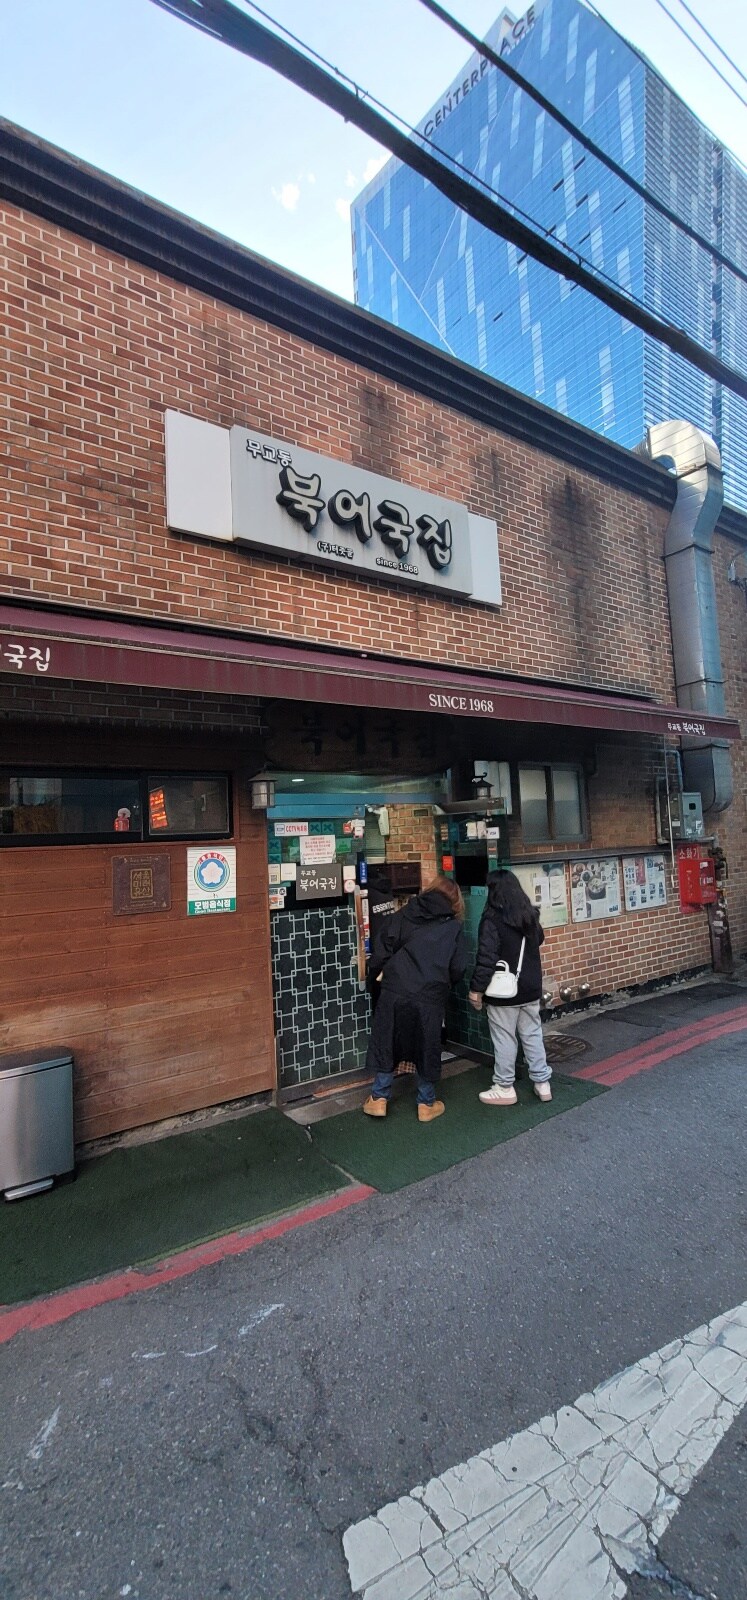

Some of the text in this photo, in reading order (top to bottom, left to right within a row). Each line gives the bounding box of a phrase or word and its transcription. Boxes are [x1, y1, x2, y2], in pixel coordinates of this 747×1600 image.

[424, 4, 535, 137] CENTERPACE
[246, 439, 292, 467] 무교동
[276, 464, 453, 570] 북어국집
[376, 557, 419, 575] since 1968
[0, 643, 50, 672] 국집
[428, 693, 494, 713] SINCE 1968
[682, 722, 706, 736] 북어국집
[679, 846, 700, 860] 소화기
[300, 876, 337, 892] 북어국집
[194, 899, 231, 910] 모범음식점
